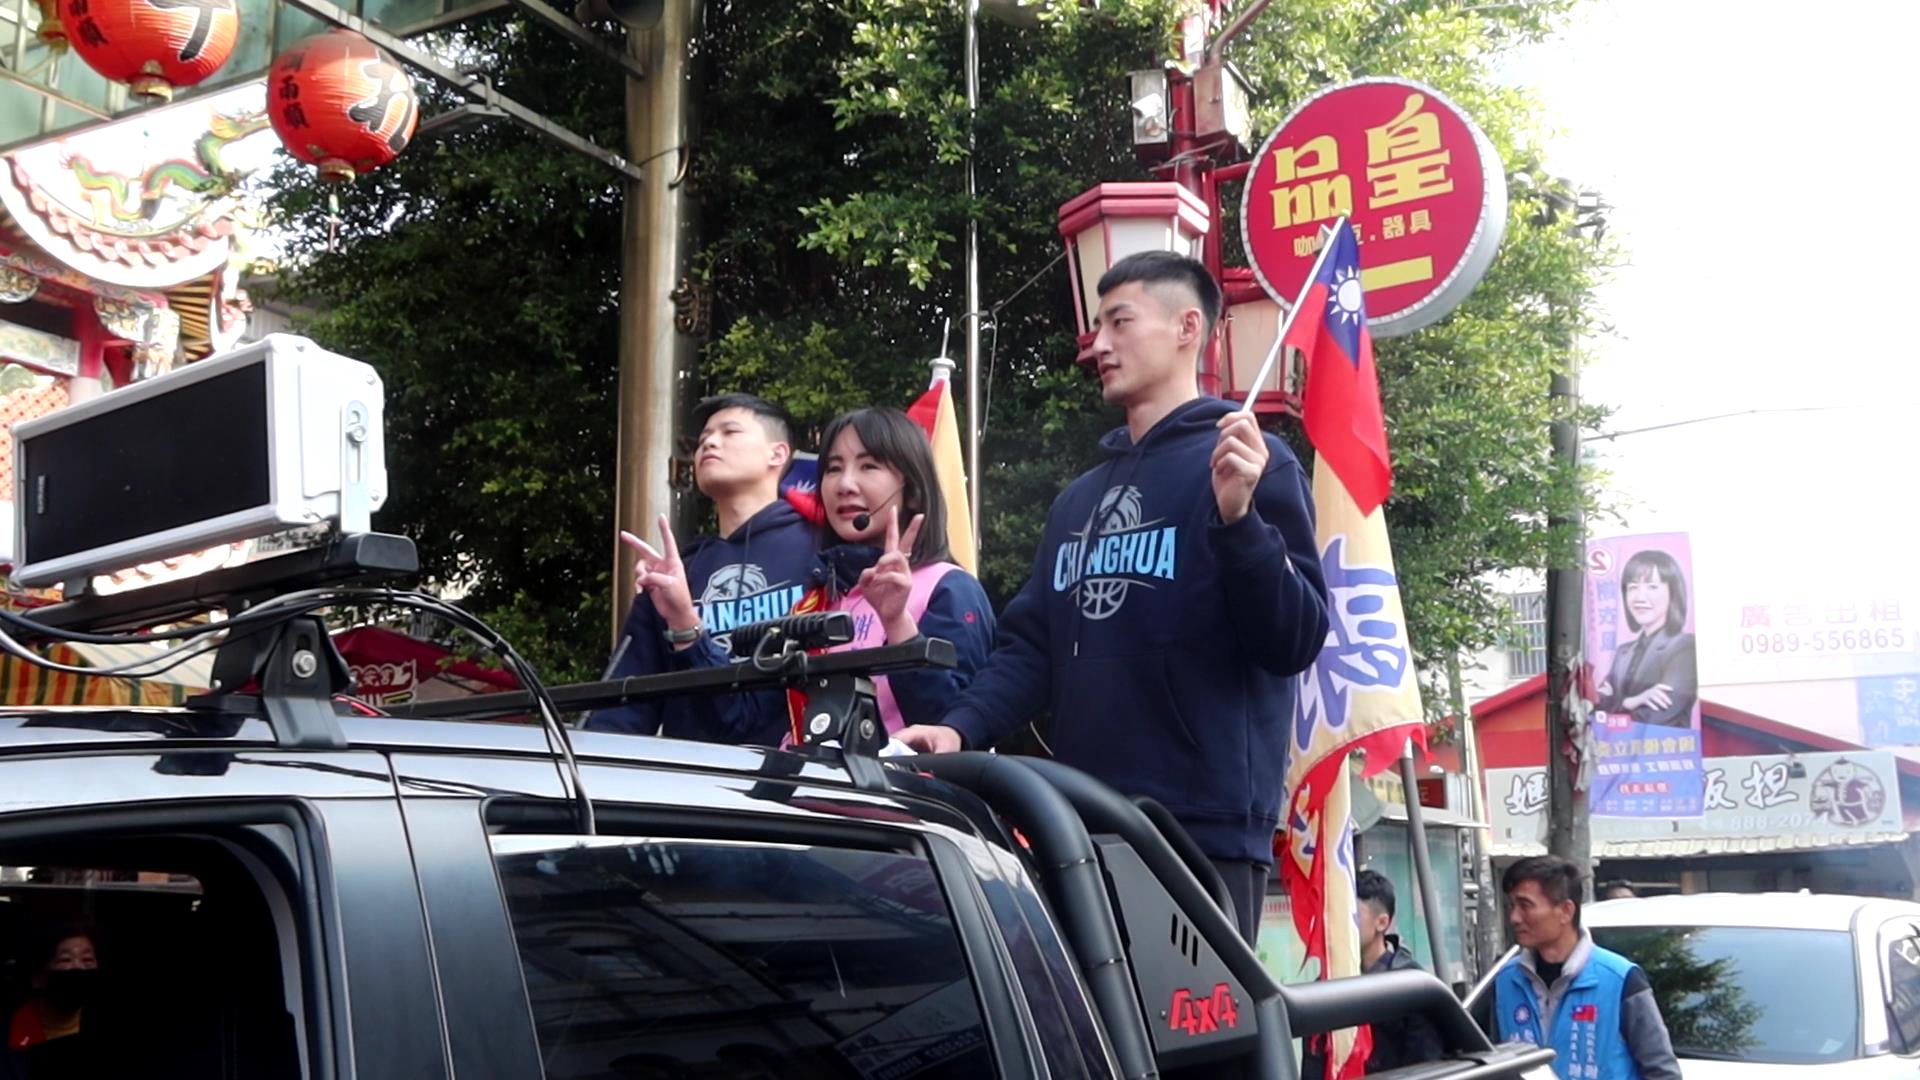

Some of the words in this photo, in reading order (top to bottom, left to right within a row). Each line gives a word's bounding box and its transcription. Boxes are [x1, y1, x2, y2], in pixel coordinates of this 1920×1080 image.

[1269, 93, 1454, 229] 品皇
[1053, 526, 1177, 592] CHNGHUA
[1740, 599, 1903, 629] 廣告出租
[1741, 627, 1905, 654] 0989-556865
